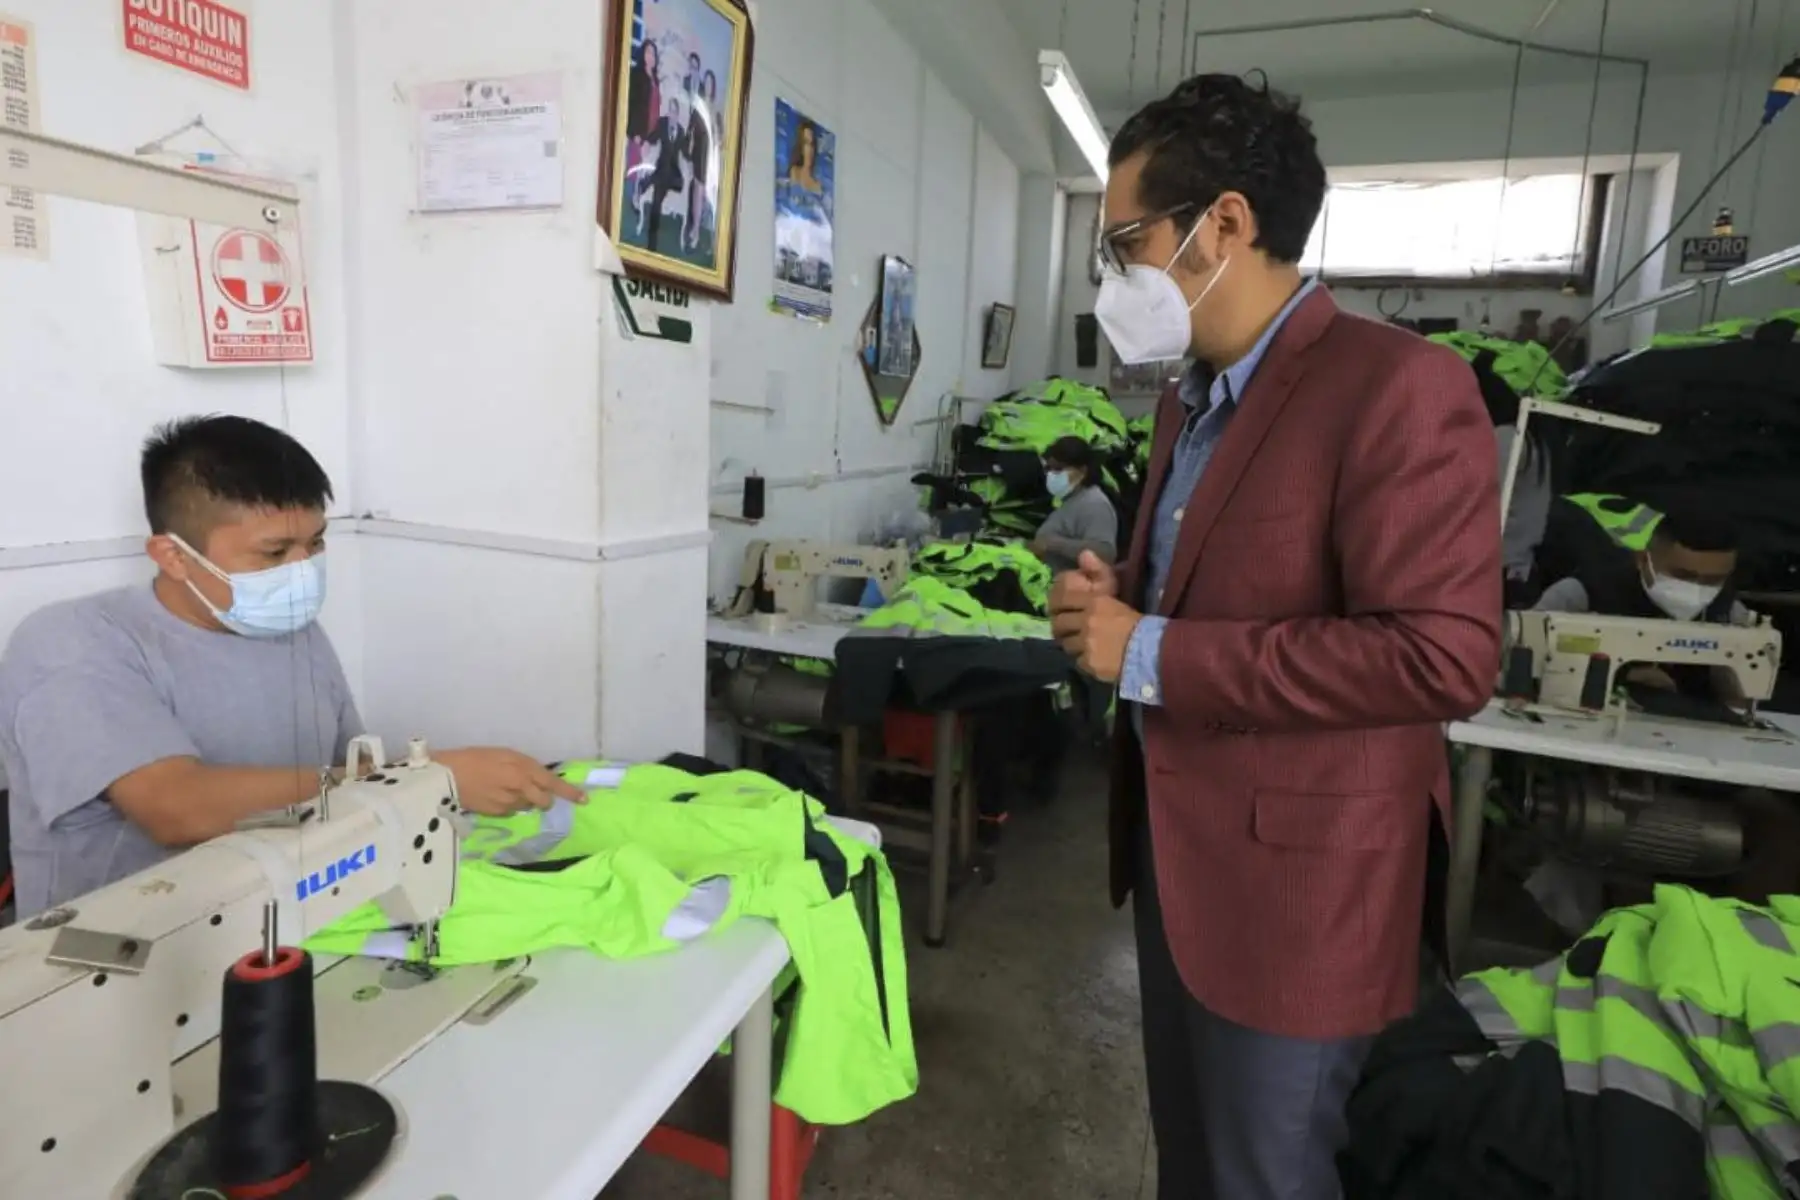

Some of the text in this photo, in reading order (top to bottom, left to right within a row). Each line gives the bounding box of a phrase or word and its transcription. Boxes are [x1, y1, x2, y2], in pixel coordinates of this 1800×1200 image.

[129, 0, 242, 49] OTIQUIN
[129, 13, 244, 70] PRIMEROS AUXILIOS
[1684, 238, 1746, 257] AFORO
[1665, 638, 1719, 651] JUKI
